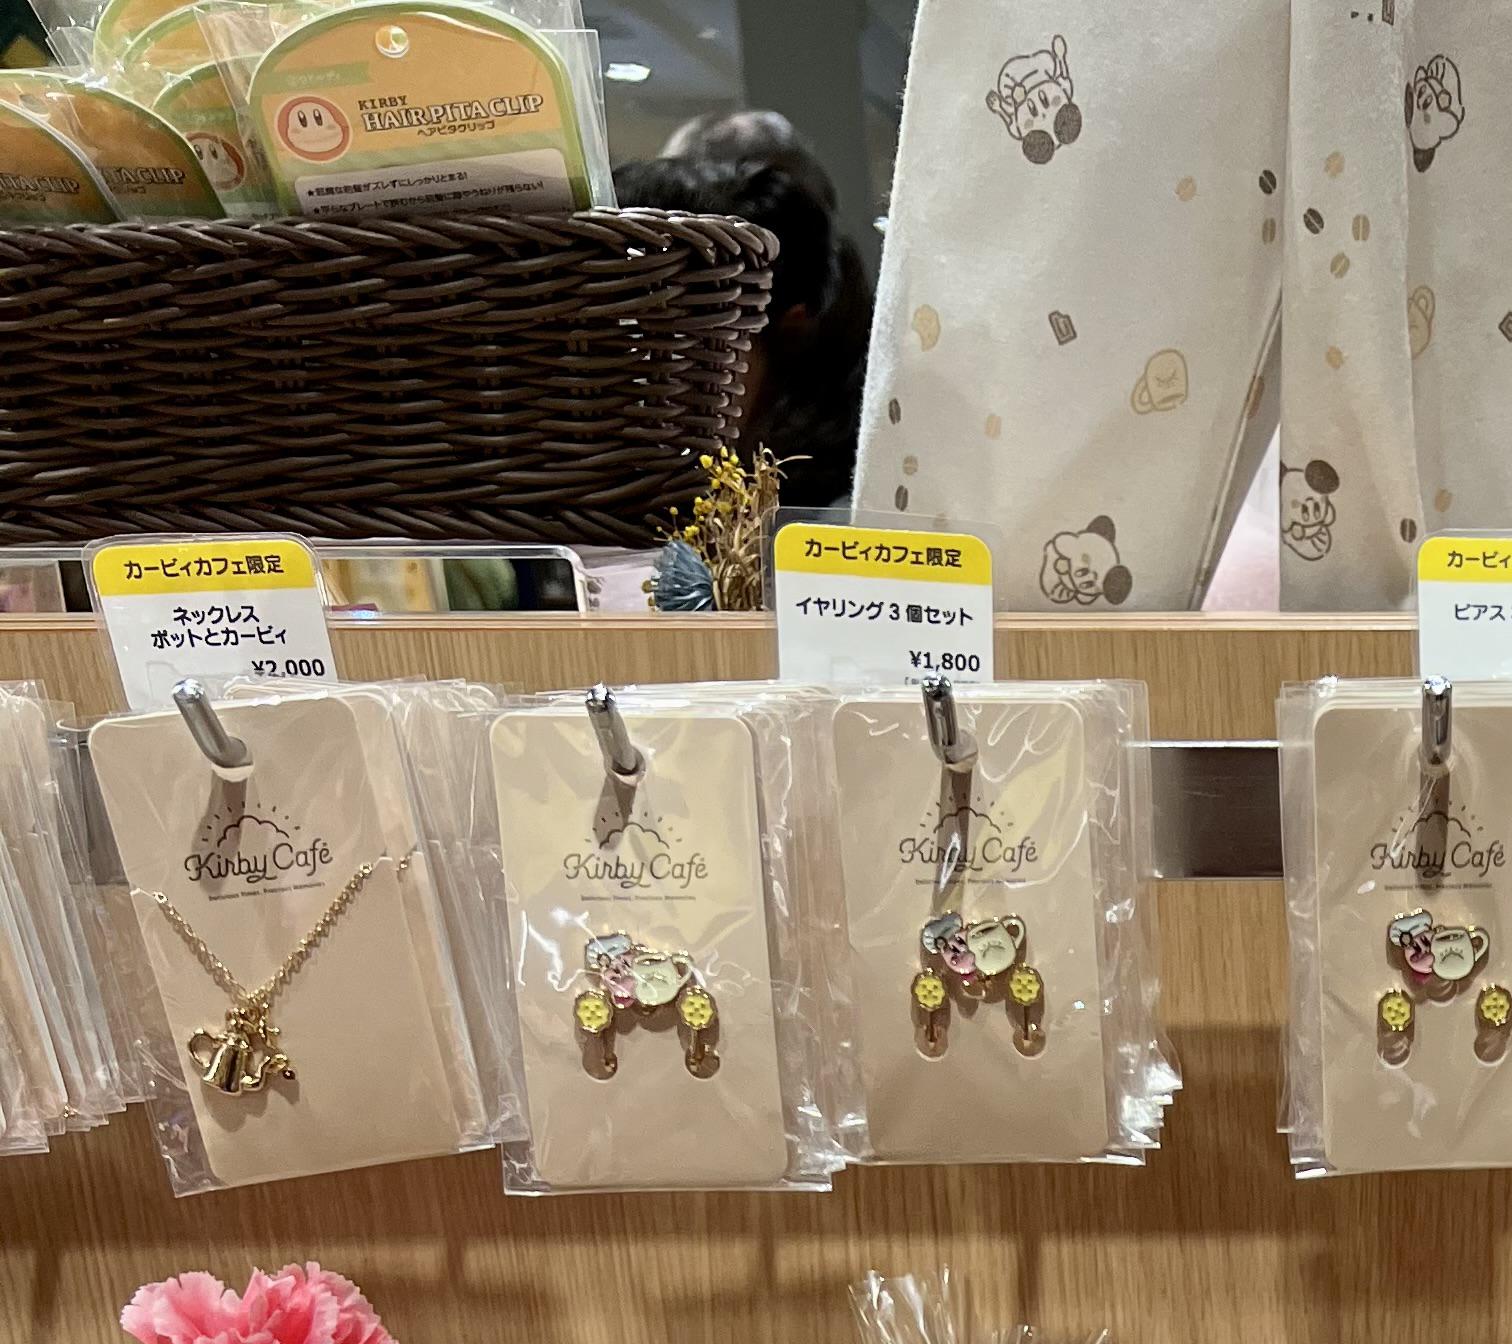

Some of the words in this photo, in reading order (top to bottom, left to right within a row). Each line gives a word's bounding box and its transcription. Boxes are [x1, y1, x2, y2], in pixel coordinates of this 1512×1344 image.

[358, 95, 407, 110] KIRBY
[362, 108, 430, 132] HAIR
[430, 101, 489, 125] PITA
[489, 94, 543, 118] CLIP
[417, 121, 495, 136] ヘアピタクリップ
[805, 539, 962, 568] カービィカフェ限定
[124, 555, 284, 580] カービィカフェ限定
[173, 605, 259, 625] ネックレス
[151, 626, 286, 649] ポットとカービィ
[251, 659, 325, 678] ¥2,000
[910, 650, 980, 672] ¥1,800
[185, 850, 277, 883] Kirby
[273, 838, 333, 876] Café
[982, 836, 1039, 872] Café
[1371, 843, 1452, 878] Kirby
[1451, 840, 1506, 877] Café
[563, 853, 651, 888] Kirby
[650, 853, 708, 888] Café
